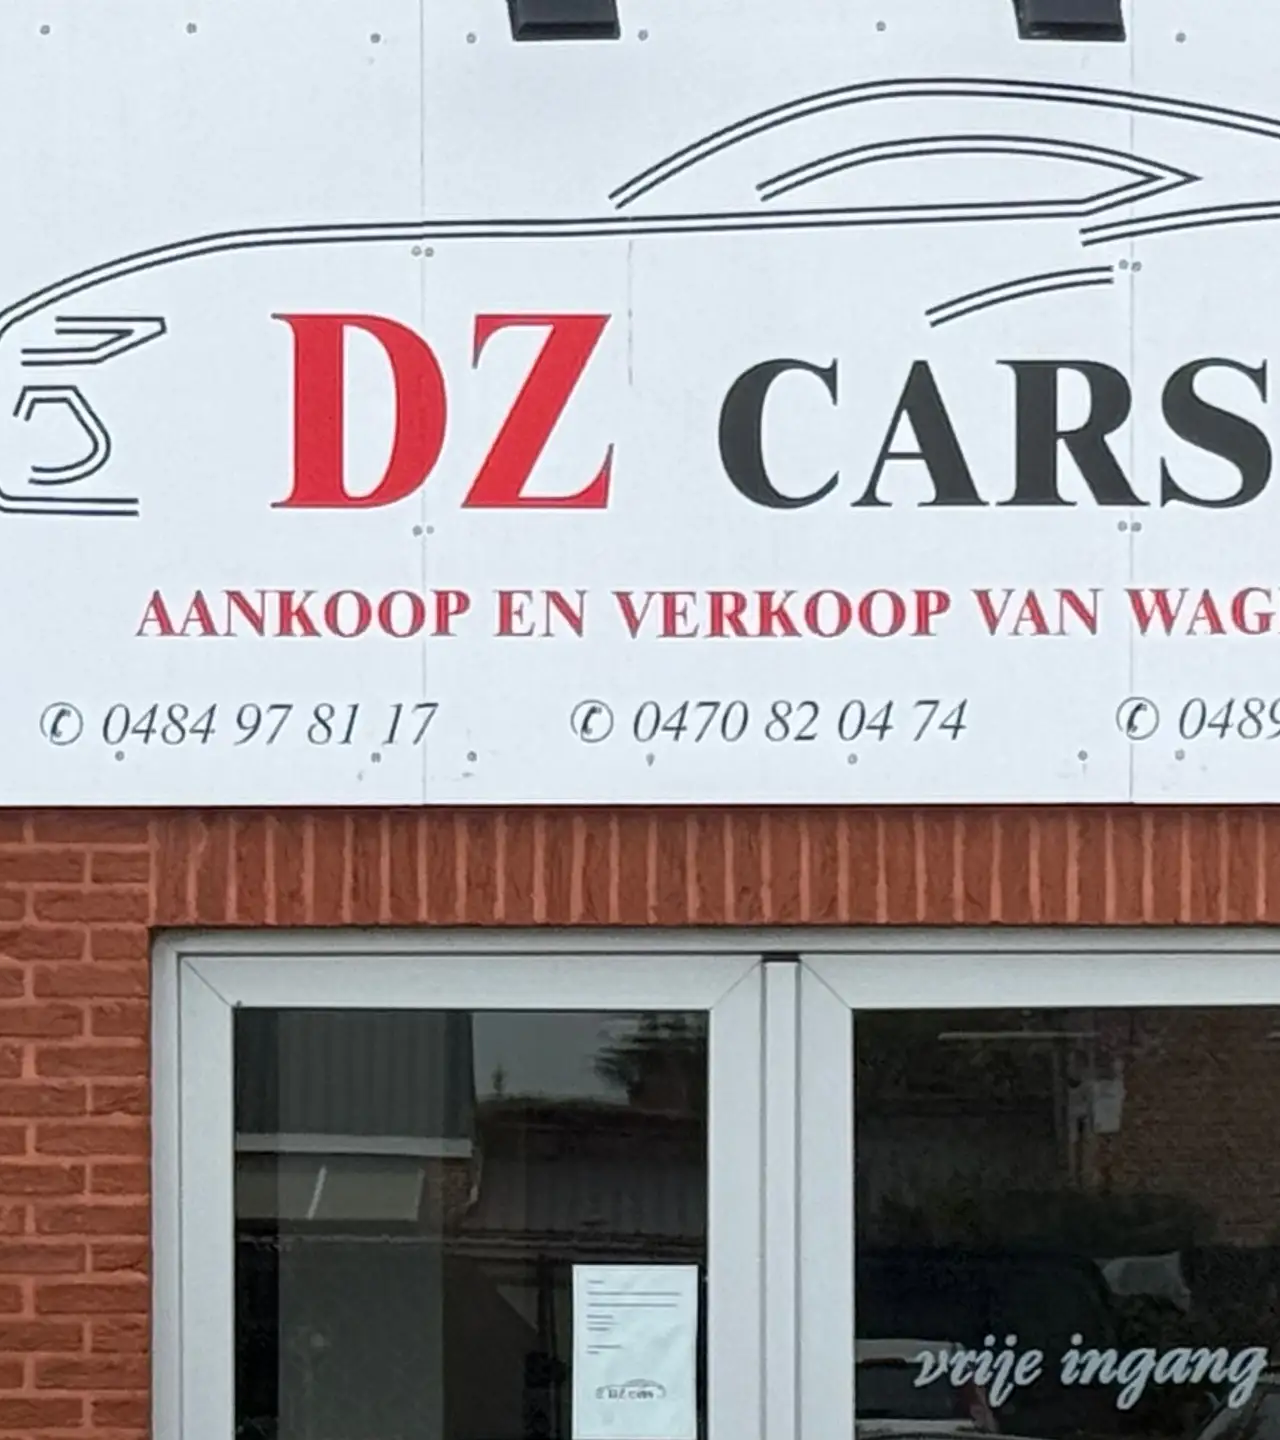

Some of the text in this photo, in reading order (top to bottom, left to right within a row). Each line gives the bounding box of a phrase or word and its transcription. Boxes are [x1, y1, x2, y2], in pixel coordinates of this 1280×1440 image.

[271, 313, 1273, 511] DZ CARS
[136, 589, 471, 639] AANKOOP
[496, 589, 587, 638] EN
[612, 589, 951, 639] VERKOOP
[973, 587, 1103, 637] VAN
[102, 702, 439, 746] 0484 97 81 17
[633, 697, 969, 744] 0470 82 04 74
[914, 1333, 1269, 1410] vrije ingang
